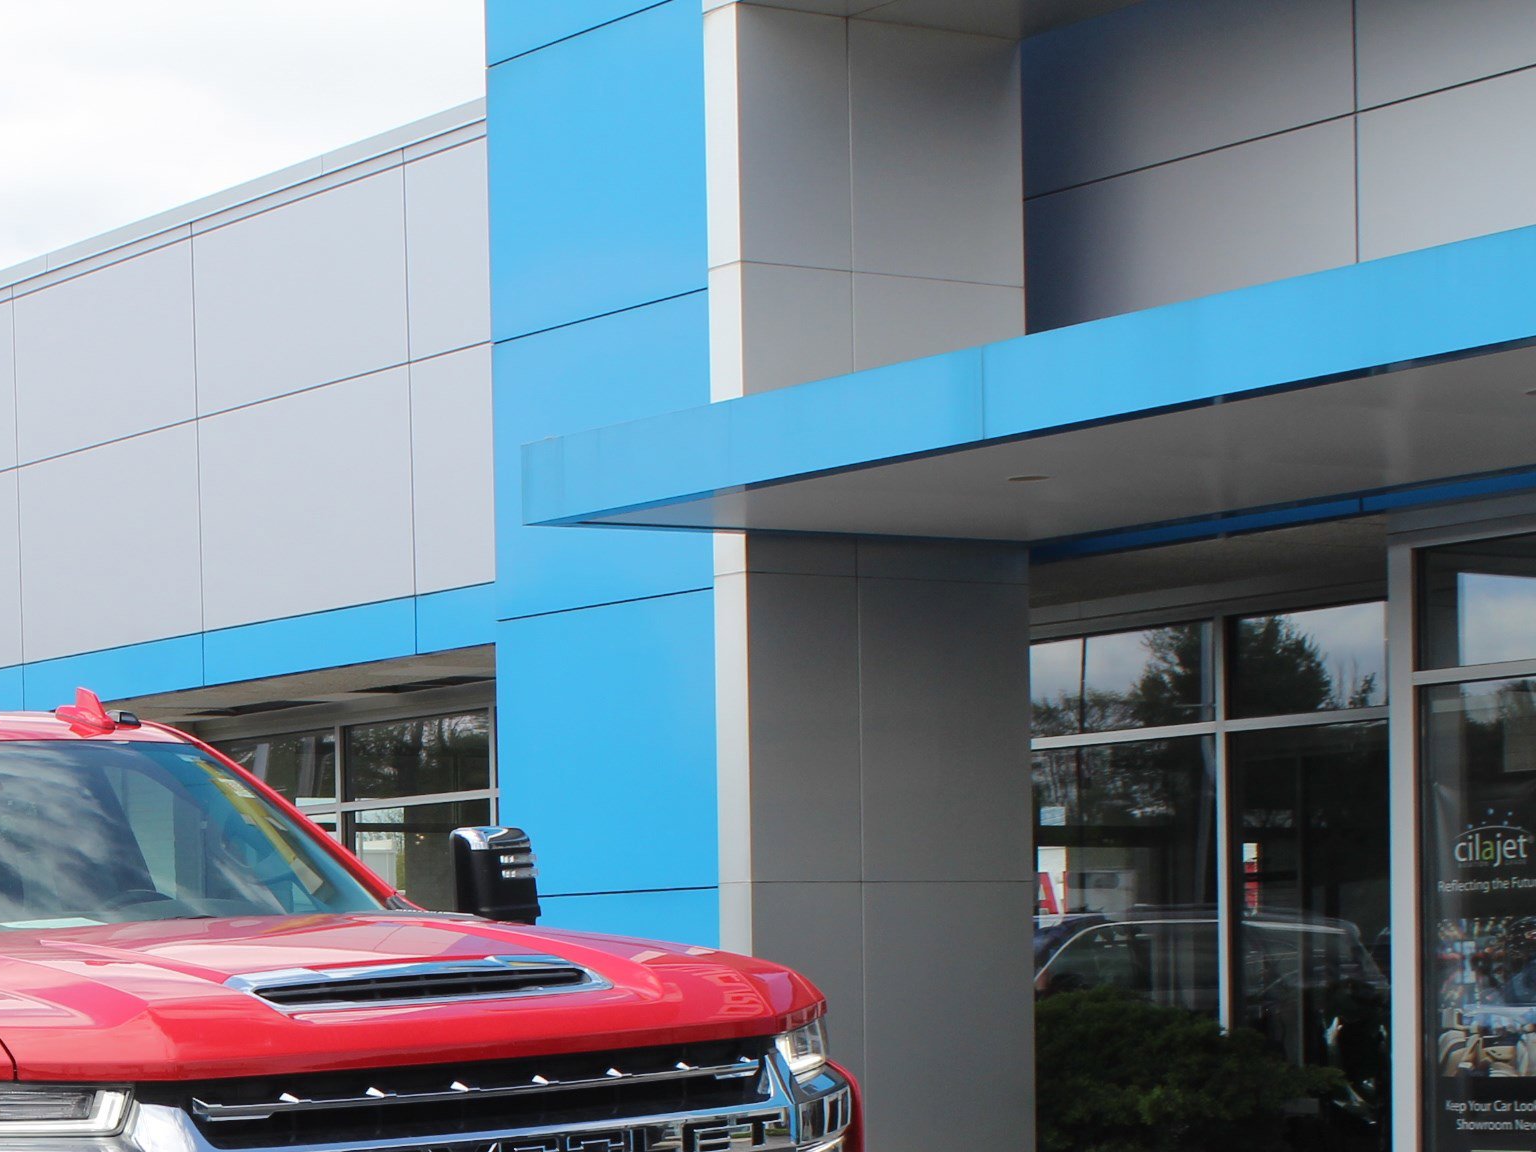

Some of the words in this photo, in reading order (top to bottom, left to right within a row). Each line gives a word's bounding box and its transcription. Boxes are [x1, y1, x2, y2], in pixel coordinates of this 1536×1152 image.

[1454, 833, 1528, 867] cilajet
[1438, 880, 1489, 893] Reflecting
[1492, 877, 1509, 889] the
[1468, 1101, 1491, 1112] Your
[1493, 1100, 1512, 1112] Car
[1456, 1118, 1513, 1131] Showroom
